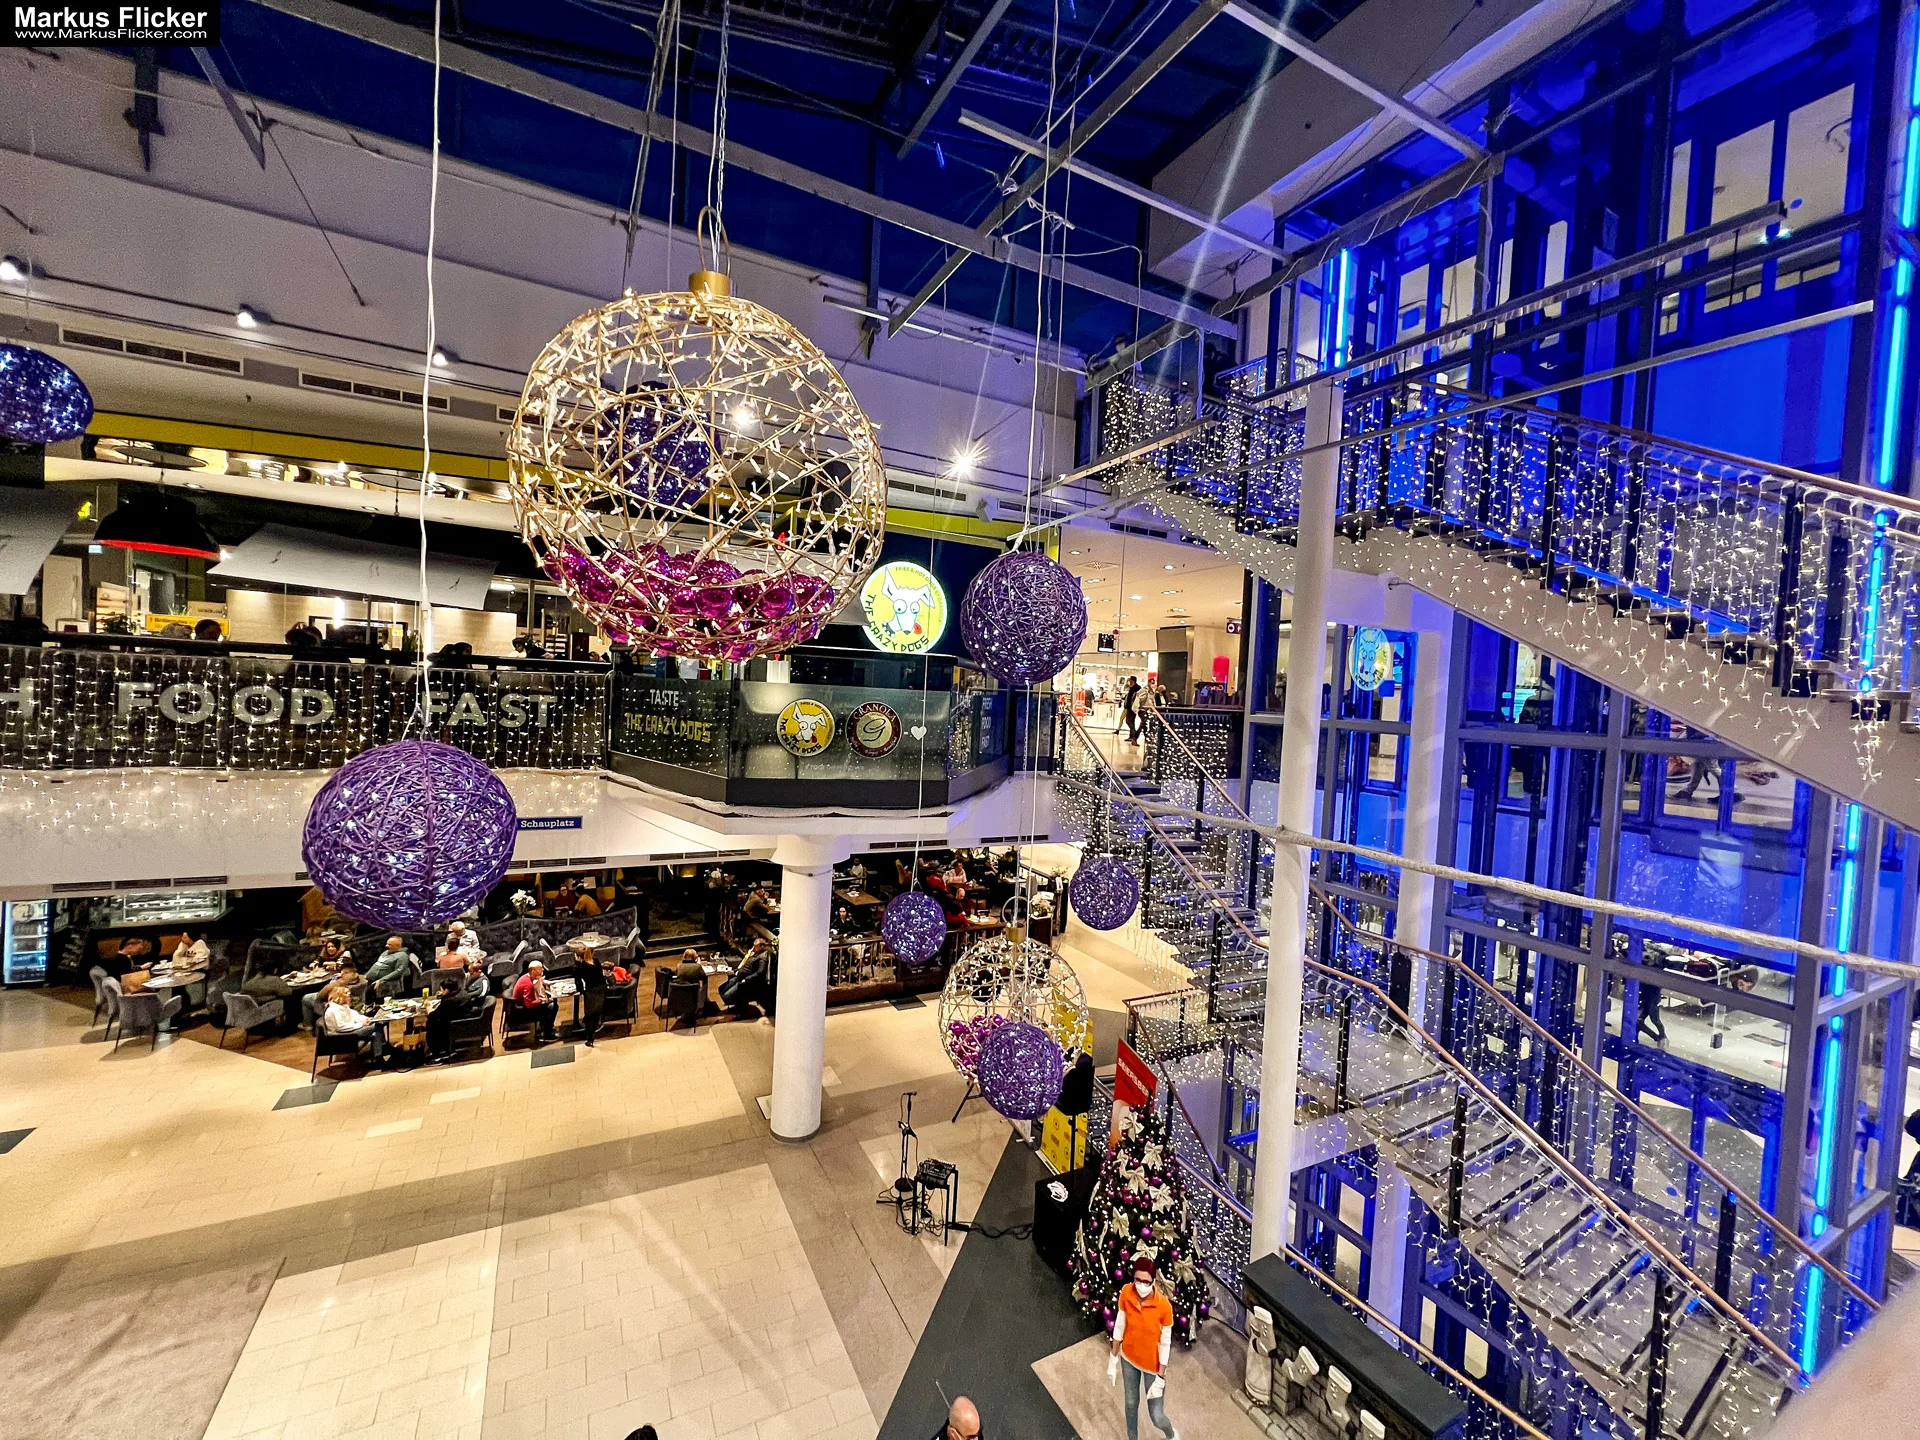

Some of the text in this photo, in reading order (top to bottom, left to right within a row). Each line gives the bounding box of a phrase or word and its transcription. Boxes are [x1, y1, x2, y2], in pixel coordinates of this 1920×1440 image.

[864, 594, 930, 652] THE CRAZY DOGS
[117, 681, 335, 725] FOOD
[421, 690, 558, 728] FAST
[649, 688, 680, 707] TASTE
[853, 703, 897, 722] GRANOLA
[624, 712, 711, 743] THE CRAZY DOGS
[520, 819, 575, 829] Schauplatz
